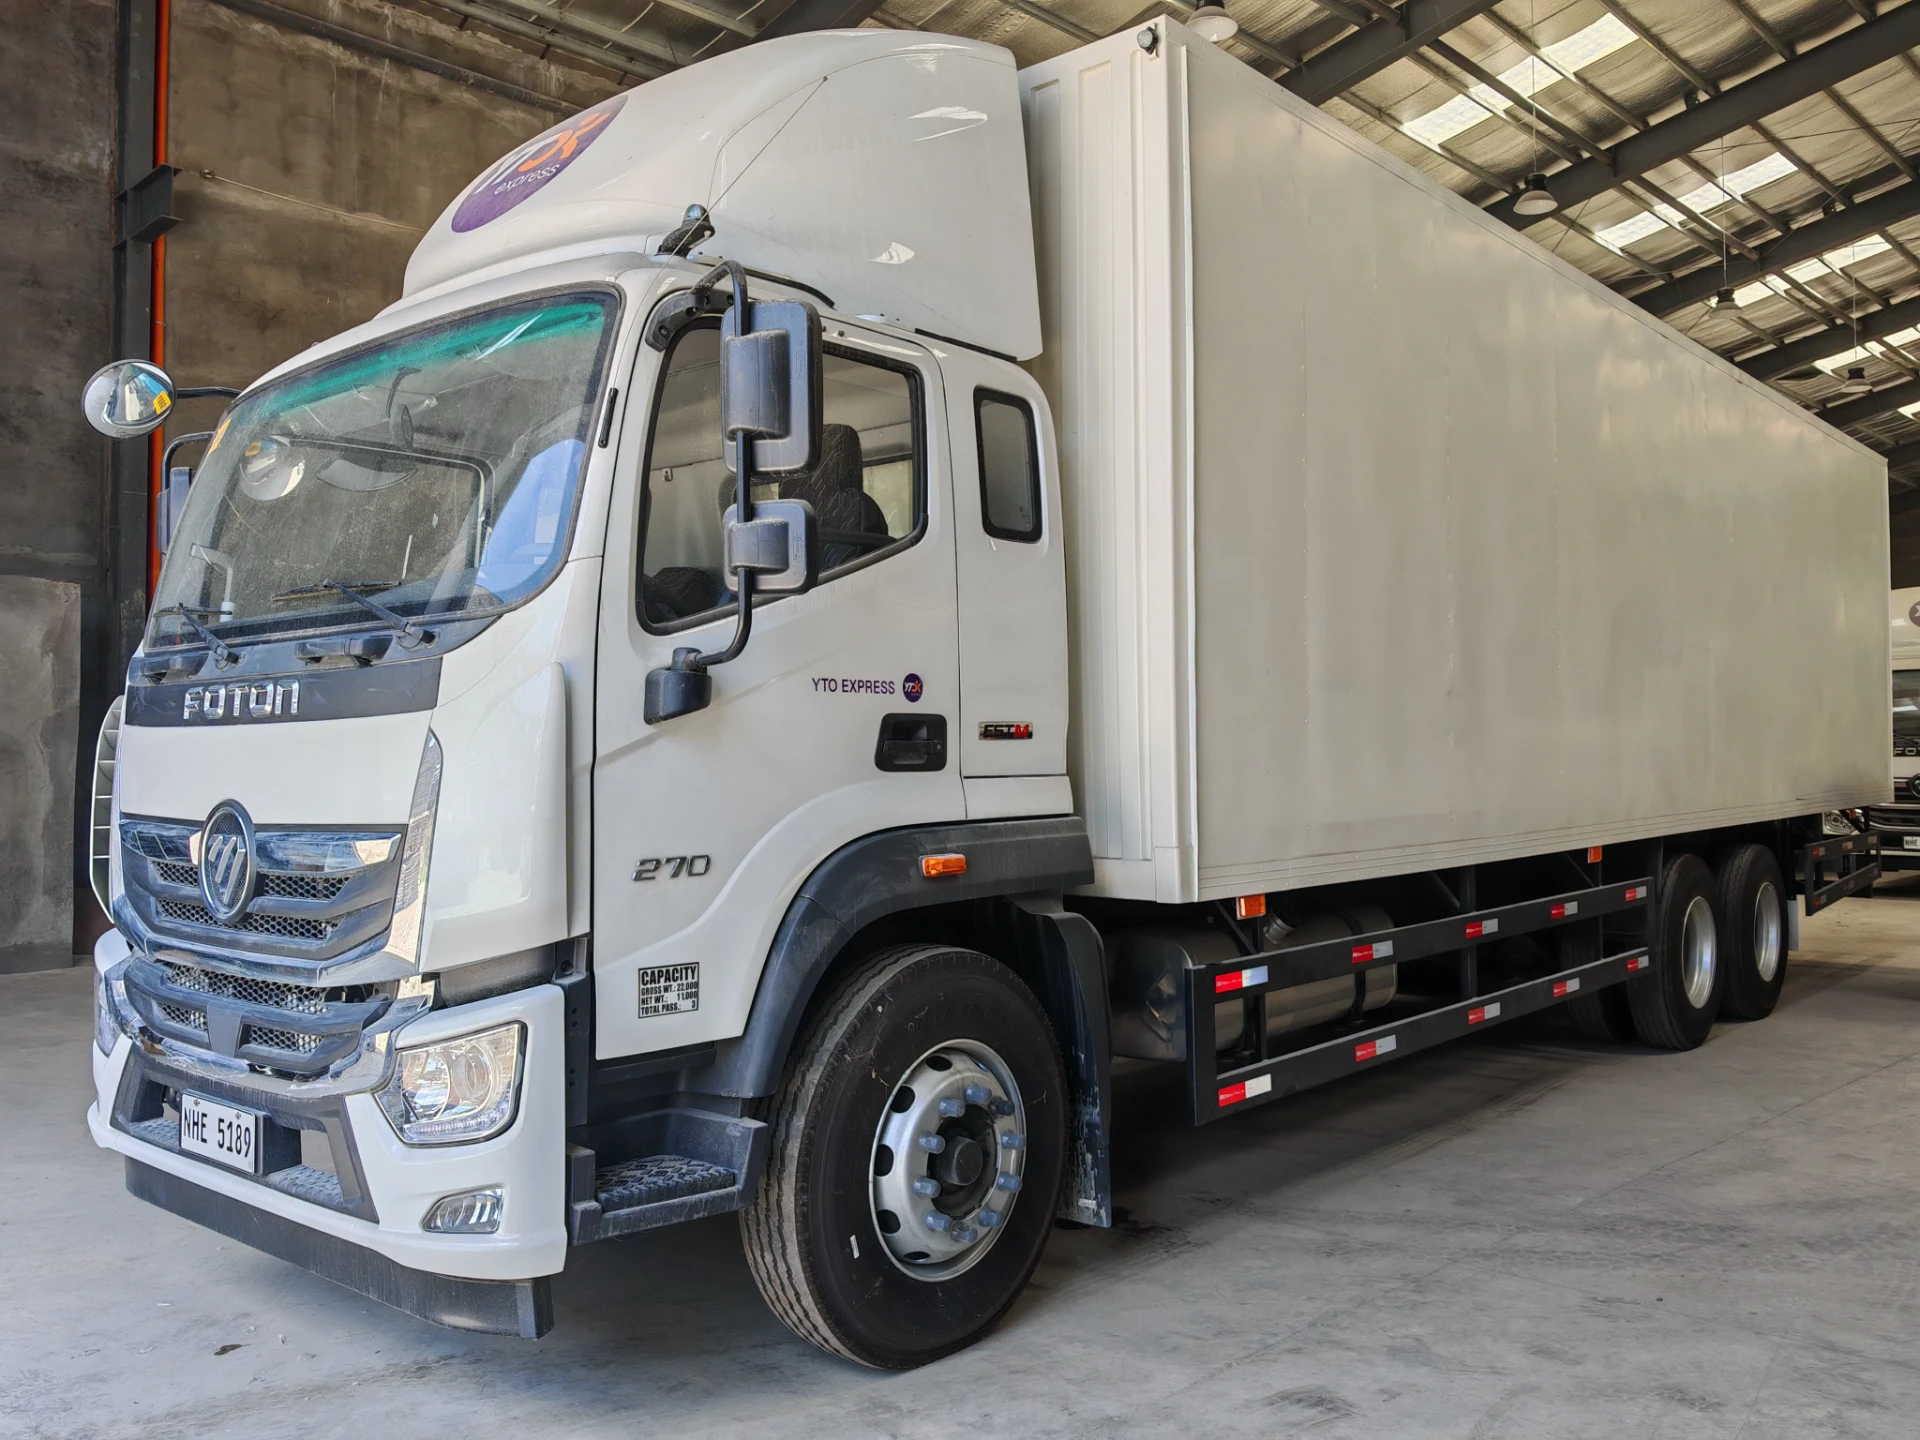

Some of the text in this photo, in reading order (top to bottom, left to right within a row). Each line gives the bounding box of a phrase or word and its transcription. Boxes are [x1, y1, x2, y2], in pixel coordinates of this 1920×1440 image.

[494, 164, 560, 194] express
[811, 678, 895, 695] YTO EXPRESS
[183, 679, 299, 720] FOTON
[1894, 747, 1920, 755] FO
[631, 854, 711, 882] 270
[641, 965, 697, 986] CAPACITY
[641, 985, 662, 997] GROSS
[641, 996, 653, 1007] NET
[641, 1004, 660, 1016] TOTAL
[691, 999, 696, 1009] 3
[183, 1107, 251, 1158] NHE 5189
